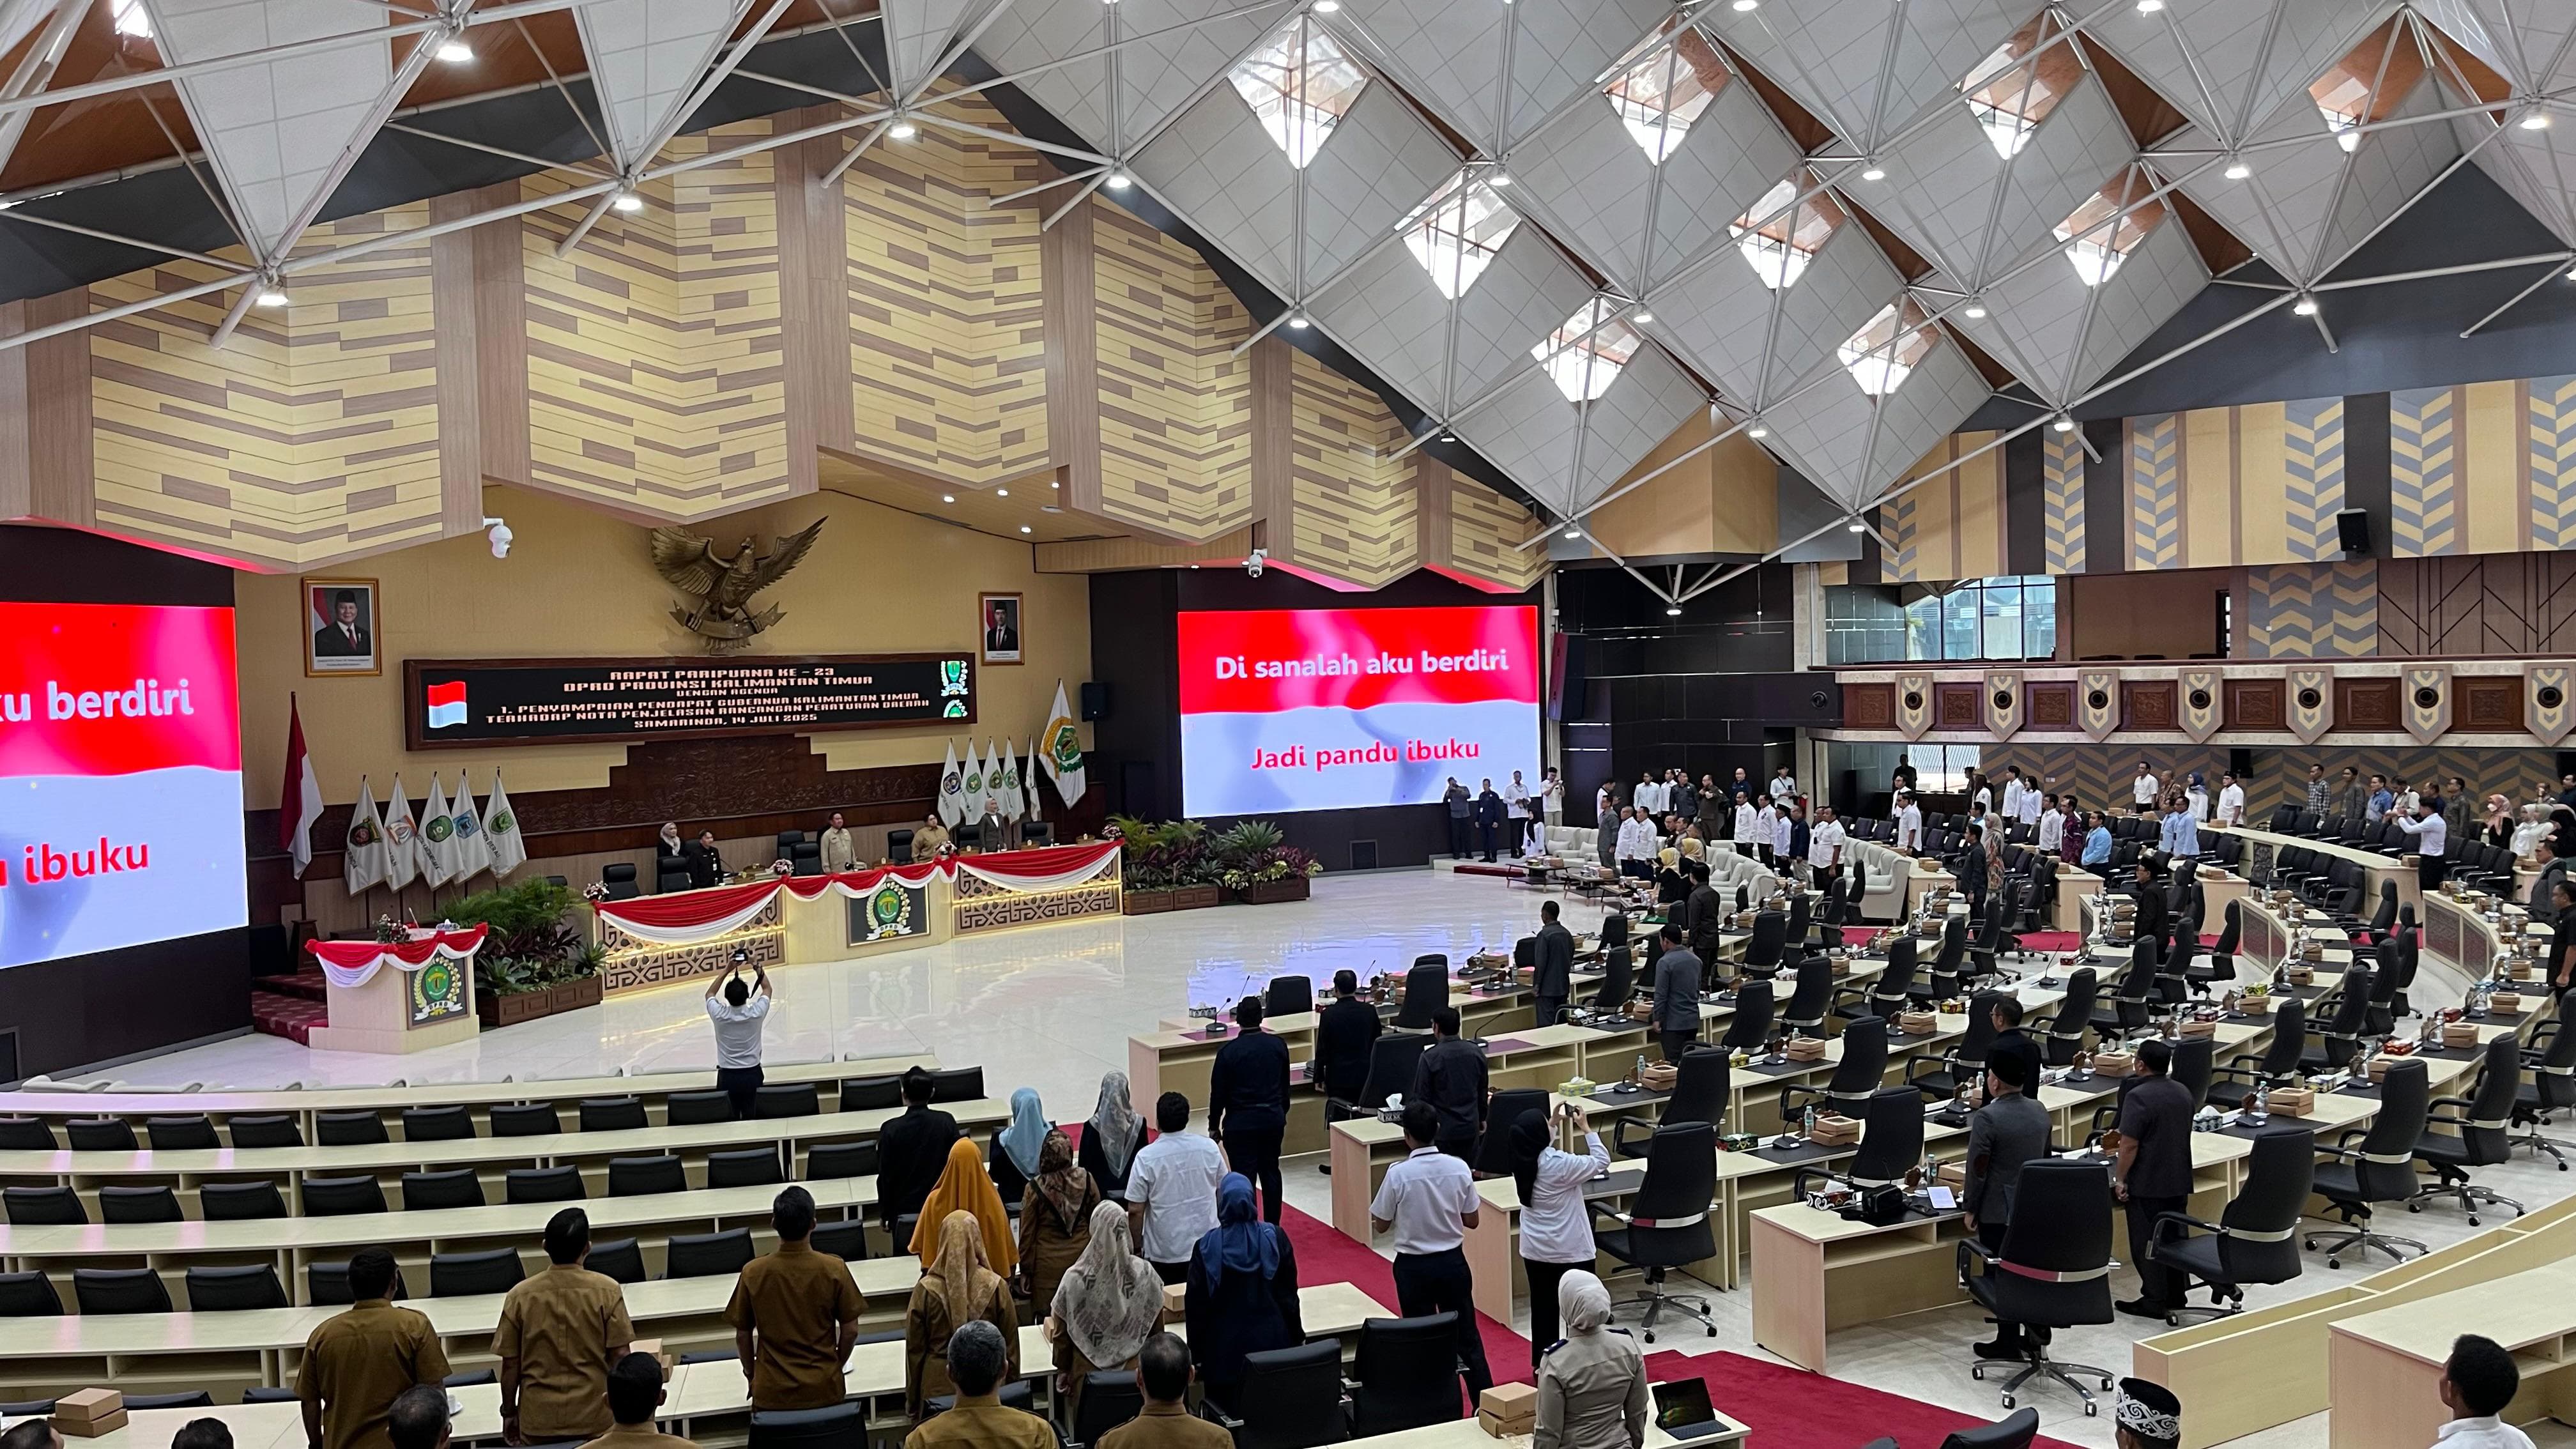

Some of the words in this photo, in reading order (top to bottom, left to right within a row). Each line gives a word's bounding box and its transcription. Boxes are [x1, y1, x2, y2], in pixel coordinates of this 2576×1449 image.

[675, 668, 773, 678] PARIPURNA
[778, 668, 797, 677] KE
[814, 667, 834, 676] 23
[1216, 656, 1247, 679] Di
[1255, 654, 1358, 678] sanalah
[1366, 652, 1413, 674] aku
[1421, 649, 1508, 672] berdiri
[564, 682, 615, 691] DPRD
[620, 680, 706, 690] PROVINSI
[711, 678, 818, 688] KALIMANTAN
[823, 676, 873, 686] TIMUR
[47, 679, 194, 720] berdiri
[518, 702, 634, 713] PENYAMPAIAN
[638, 700, 713, 709] PENDAPAT
[717, 697, 789, 707] GUBERNUR
[793, 694, 877, 705] KALIMANTAN
[880, 692, 919, 702] TIMUR
[486, 713, 571, 724] TERHADAP
[576, 711, 617, 720] NOTA
[622, 707, 714, 719] PENJELASAN
[719, 704, 802, 715] RANCANGAN
[806, 703, 879, 712] PERATURAN
[883, 700, 930, 709] DAERAH
[634, 717, 728, 728] SAMARINDA,
[750, 714, 779, 723] JULI
[783, 713, 817, 722] 2025
[1252, 746, 1307, 769] Jadi
[1315, 740, 1398, 772] pandu
[1407, 738, 1480, 762] ibuku
[24, 837, 150, 885] ibuku
[429, 1001, 448, 1009] DPRD
